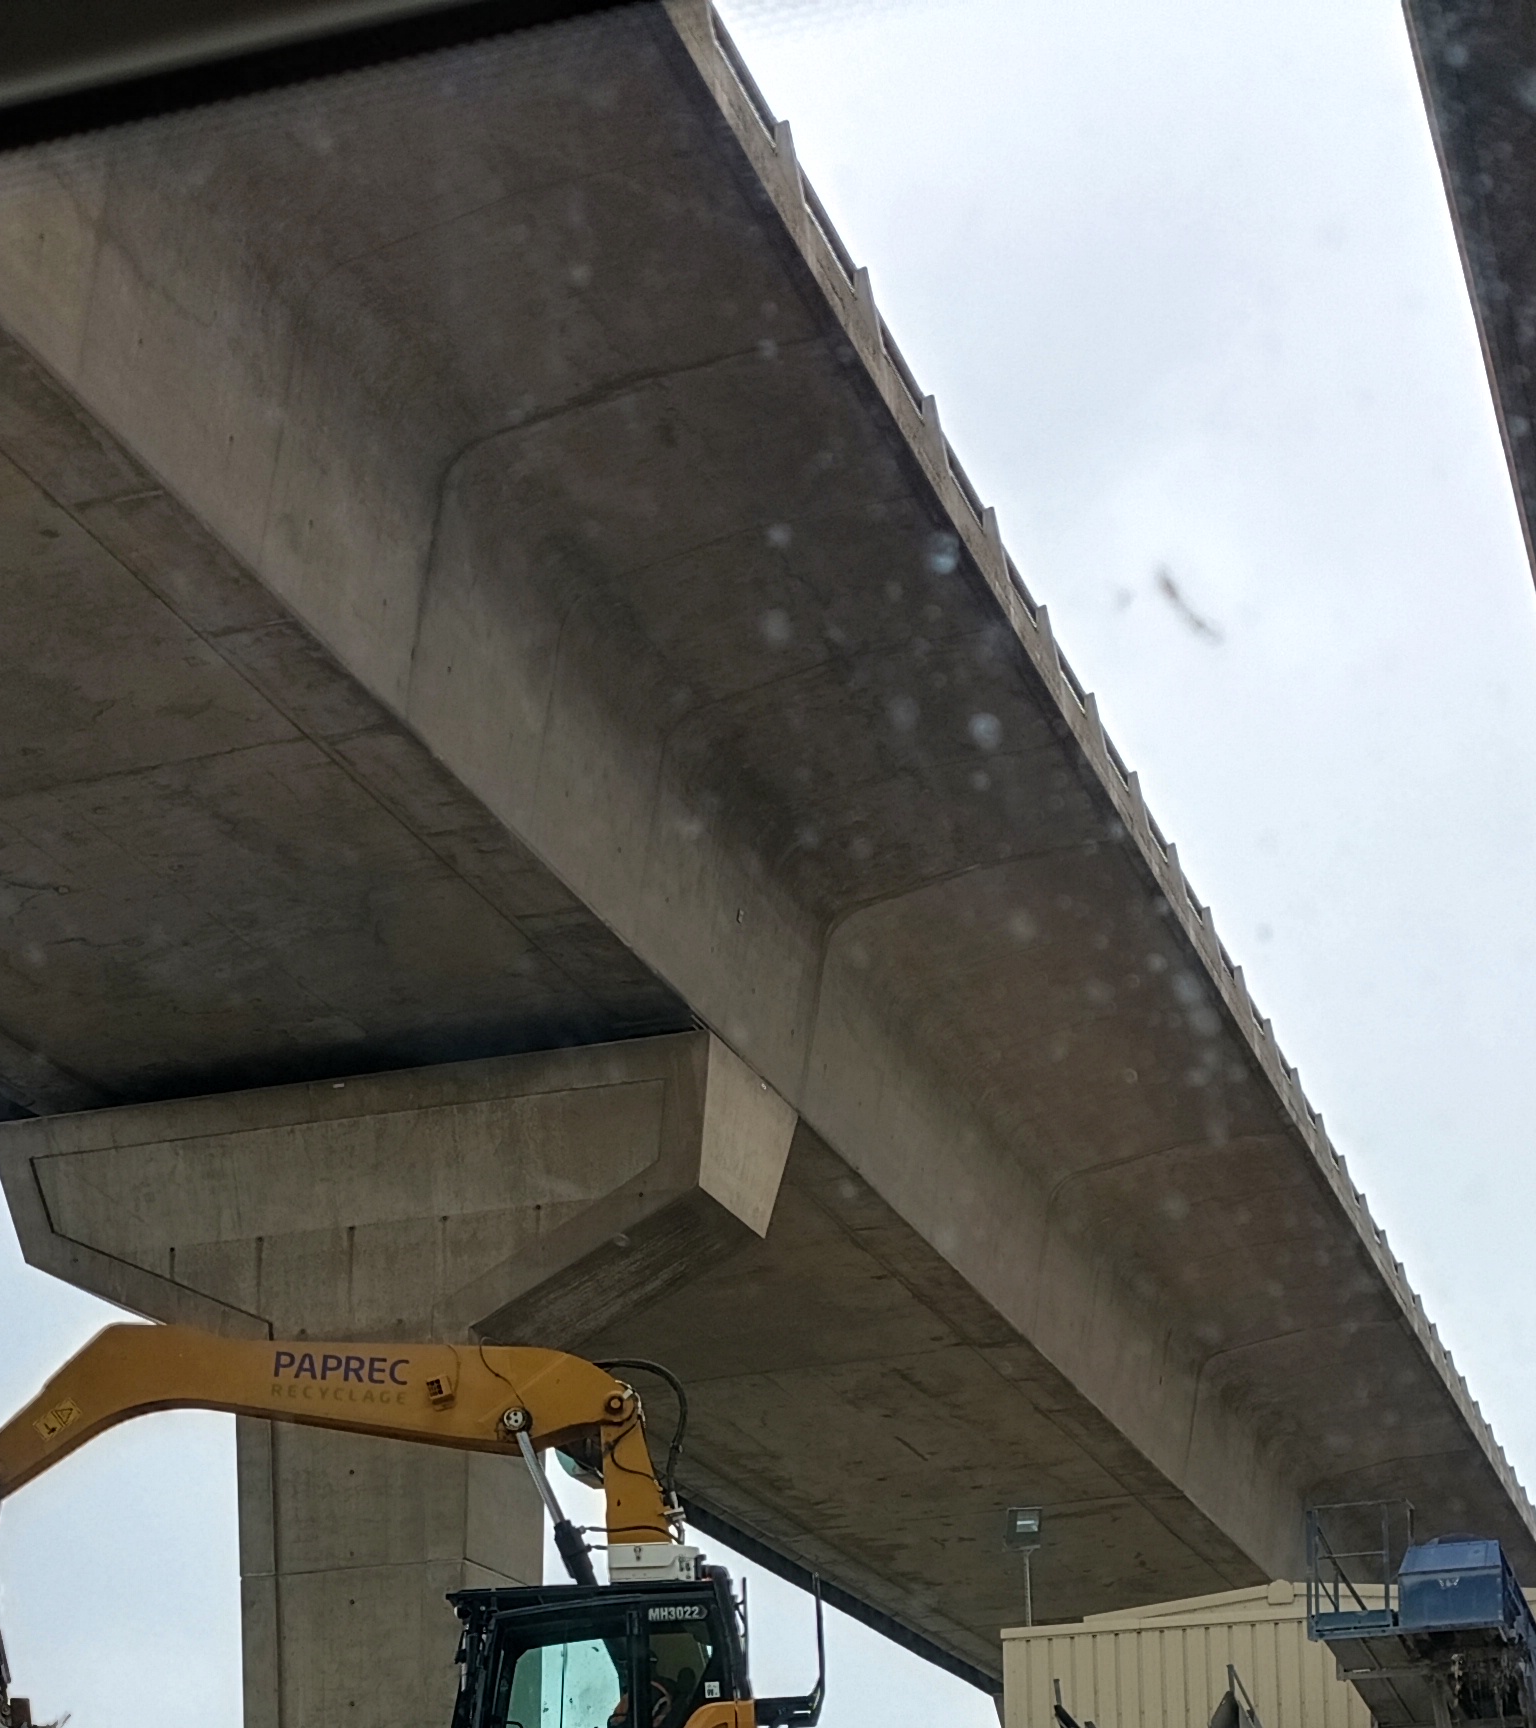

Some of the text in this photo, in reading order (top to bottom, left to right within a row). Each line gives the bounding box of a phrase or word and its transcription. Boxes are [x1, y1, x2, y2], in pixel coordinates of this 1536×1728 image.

[273, 1351, 410, 1386] PAPREC
[271, 1383, 407, 1405] RECYCLAGE
[648, 1606, 699, 1621] MH3022
